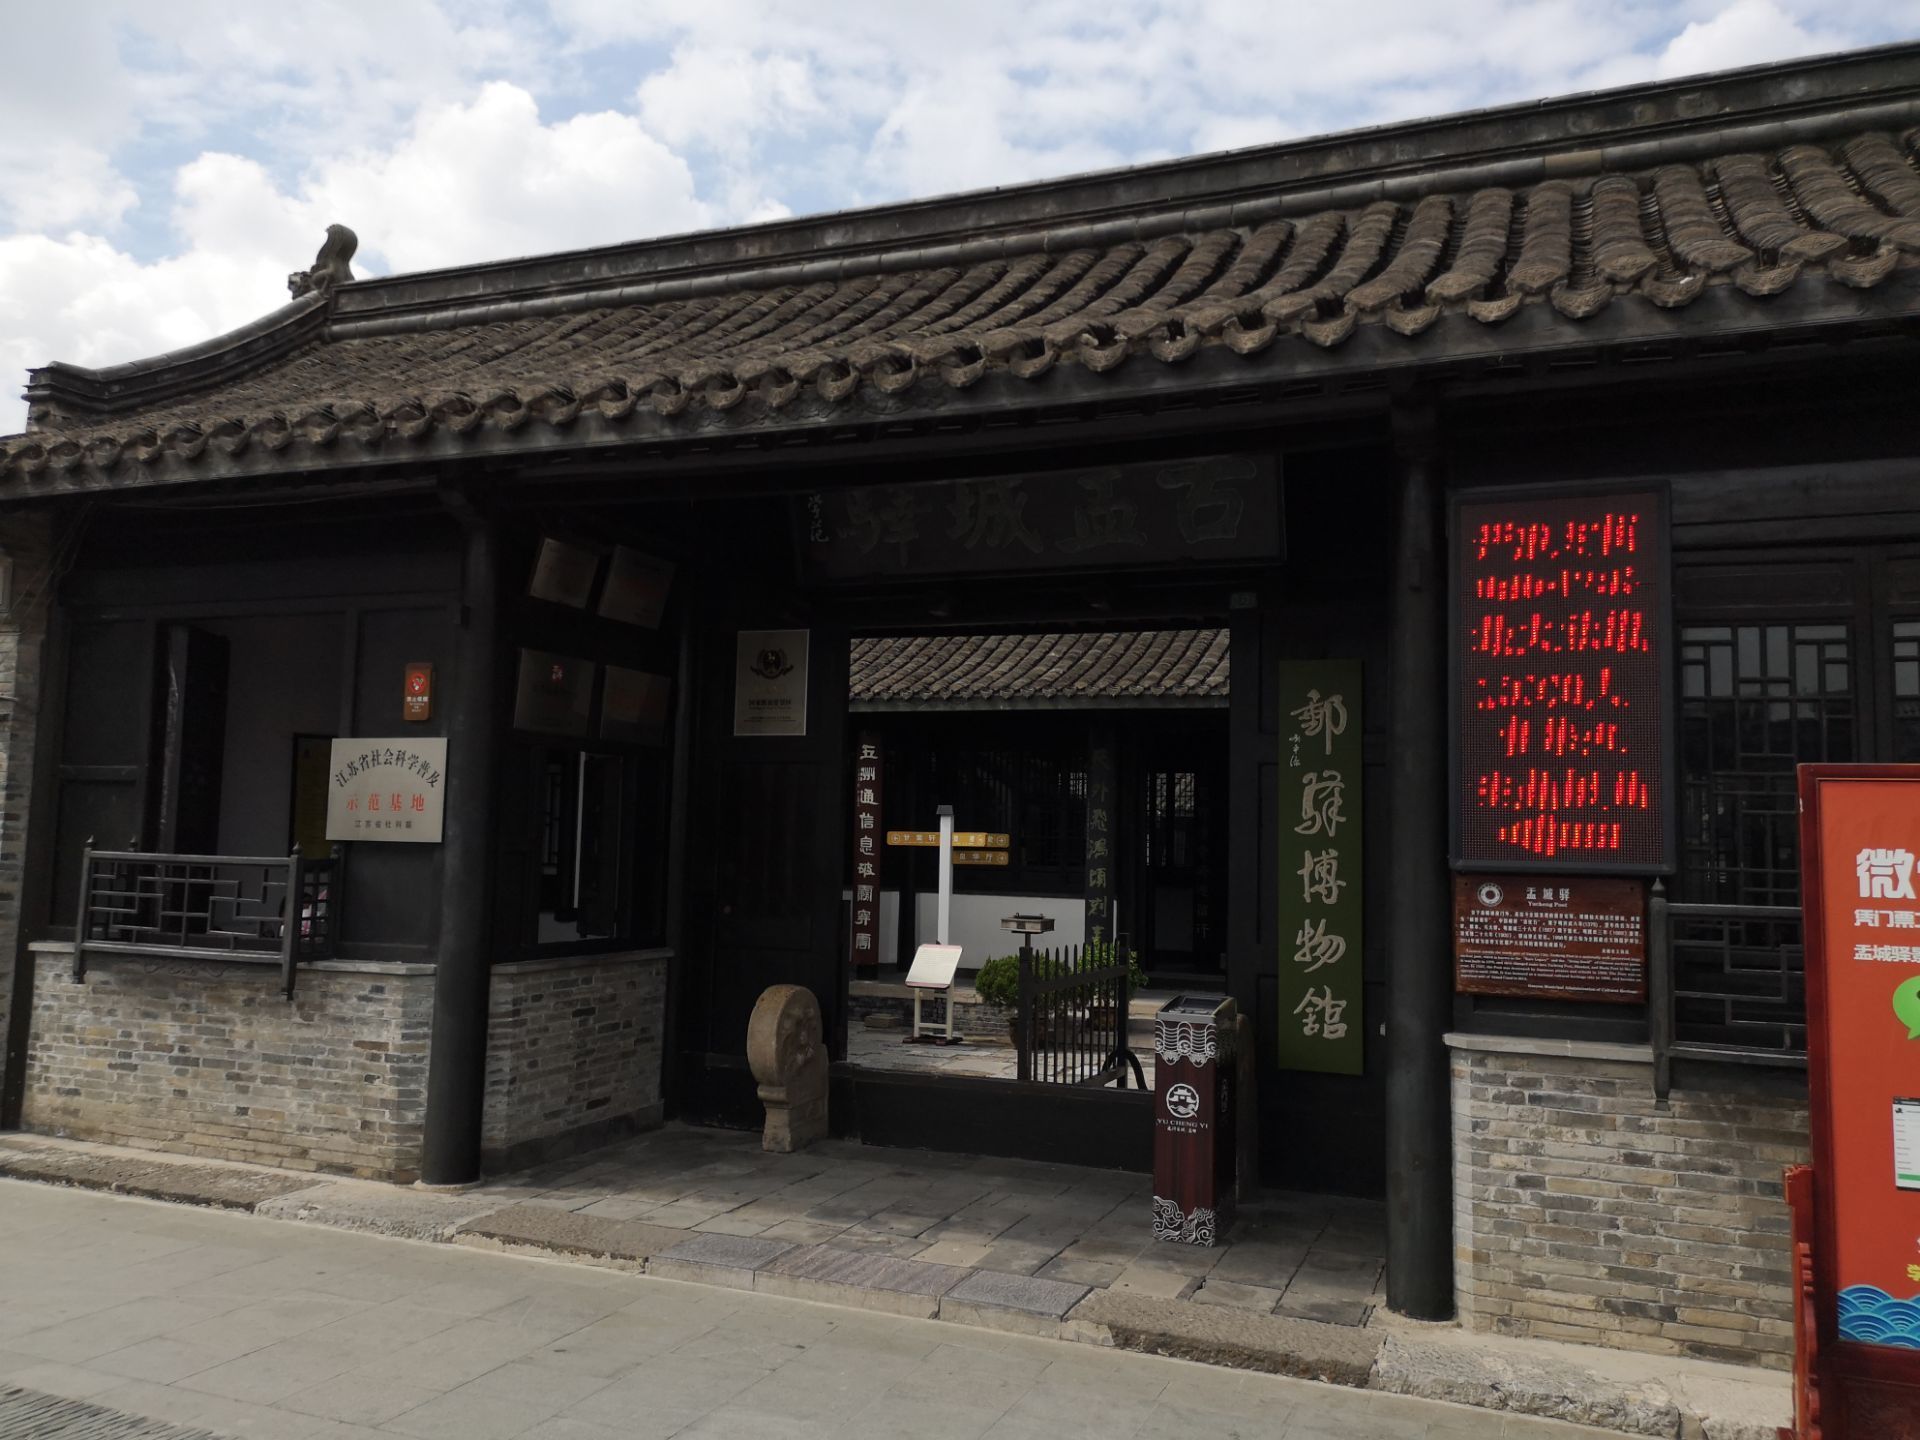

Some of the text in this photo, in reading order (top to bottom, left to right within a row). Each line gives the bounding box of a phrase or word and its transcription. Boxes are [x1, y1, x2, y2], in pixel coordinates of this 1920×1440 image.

[335, 747, 441, 788] 江苏省社会科学普及
[346, 792, 425, 812] 示范基地
[1856, 849, 1920, 899] 微
